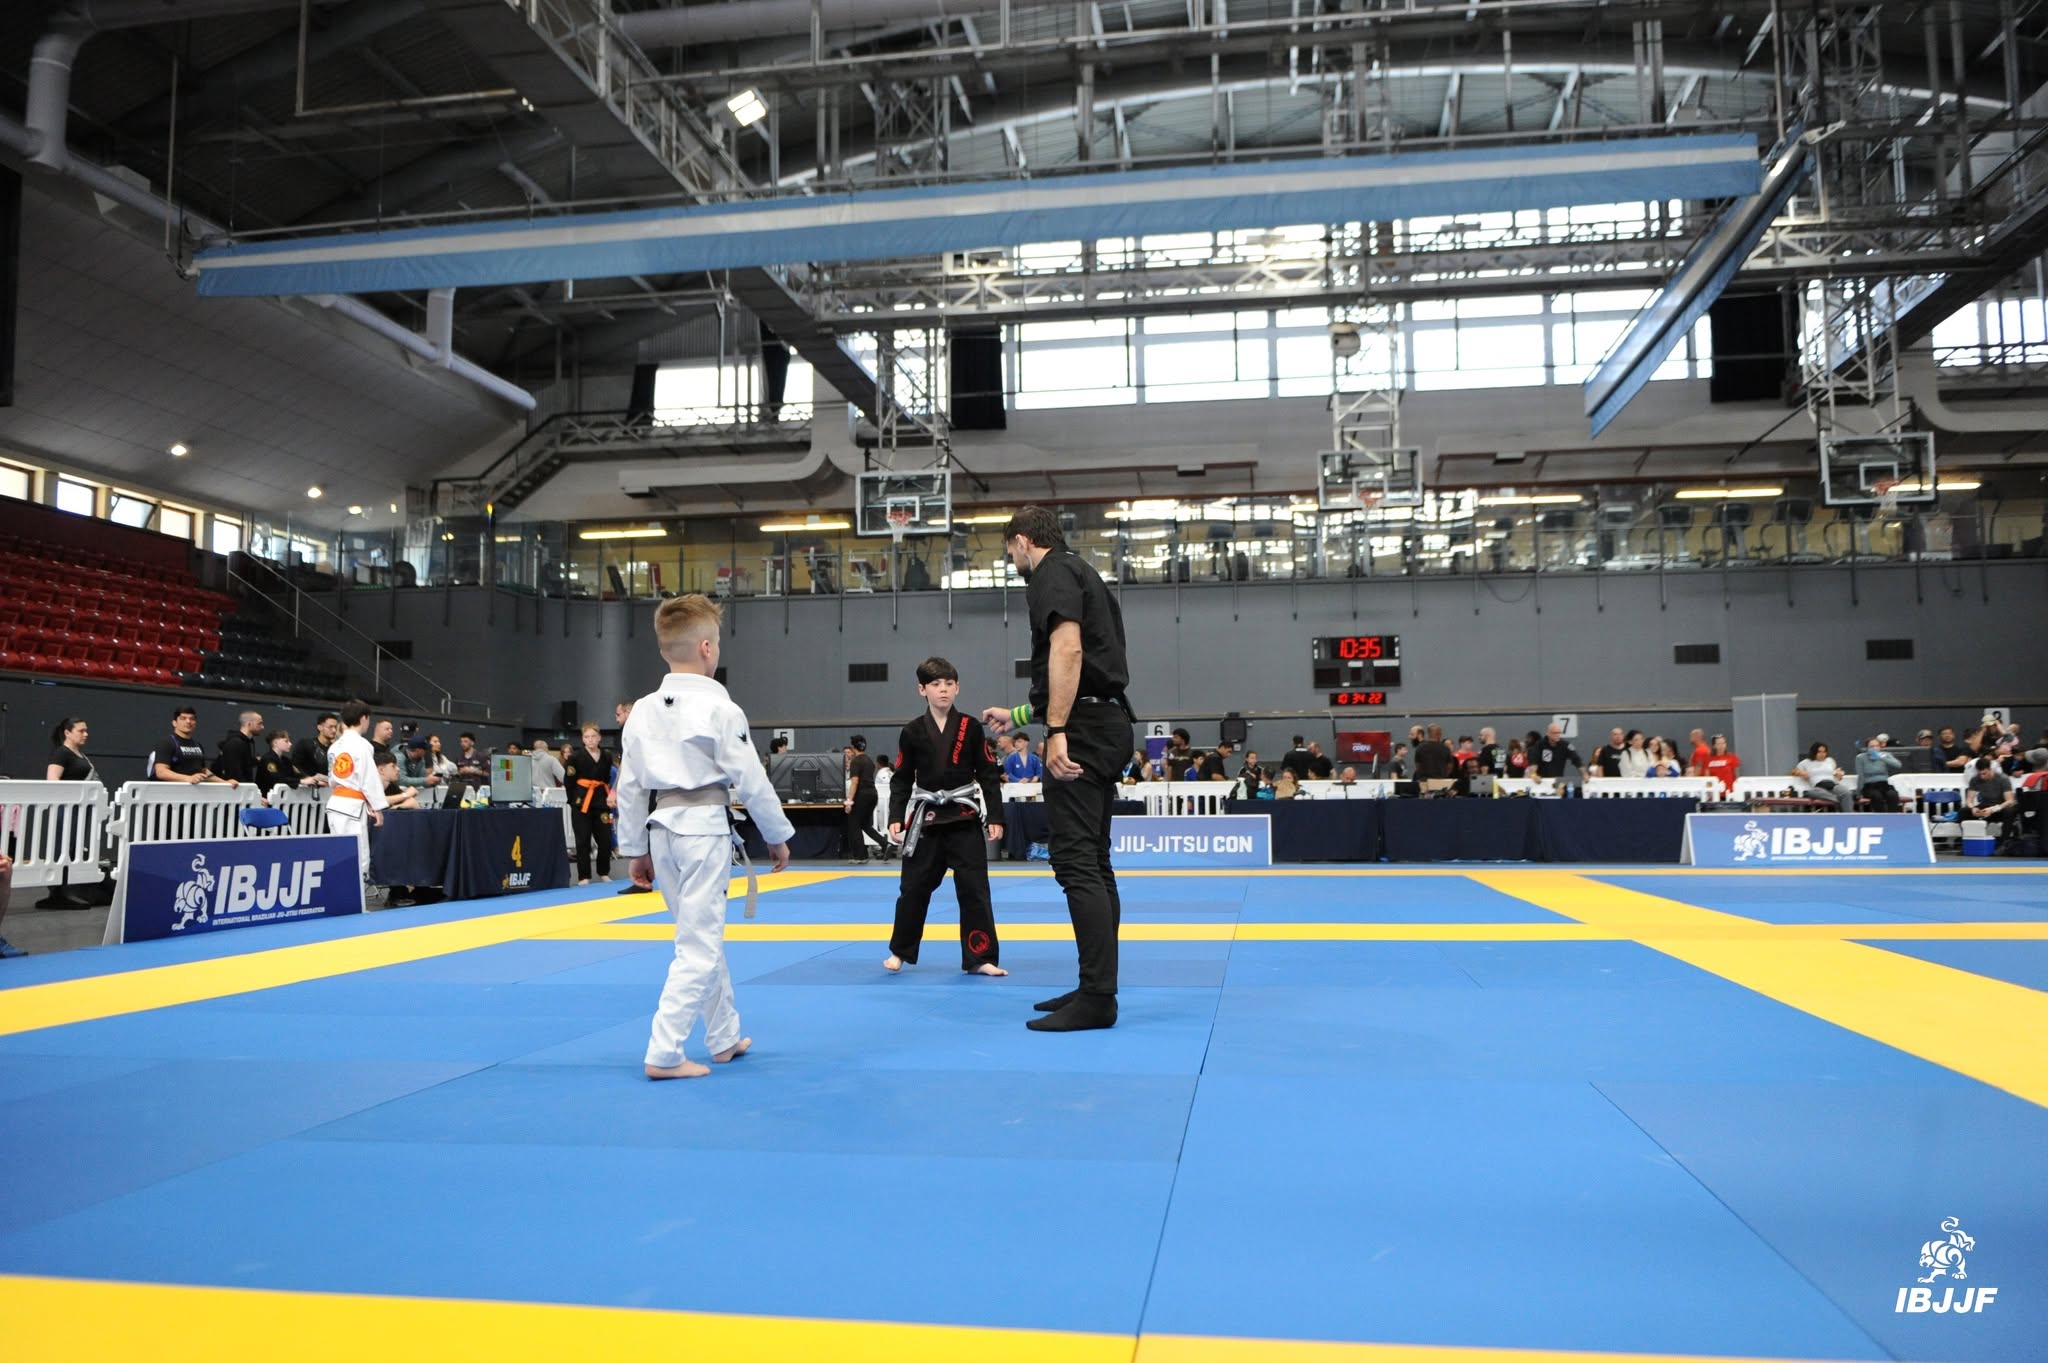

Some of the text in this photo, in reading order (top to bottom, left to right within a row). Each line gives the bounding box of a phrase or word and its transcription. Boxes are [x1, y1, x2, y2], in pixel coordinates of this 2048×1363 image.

[1341, 637, 1382, 659] 10:35
[1154, 724, 1164, 736] 6
[1560, 717, 1571, 734] 7
[511, 835, 522, 867] 4
[1114, 835, 1253, 853] JIU-JITSU CON
[1771, 827, 1884, 855] IBJJF
[213, 860, 325, 915] IBJJF
